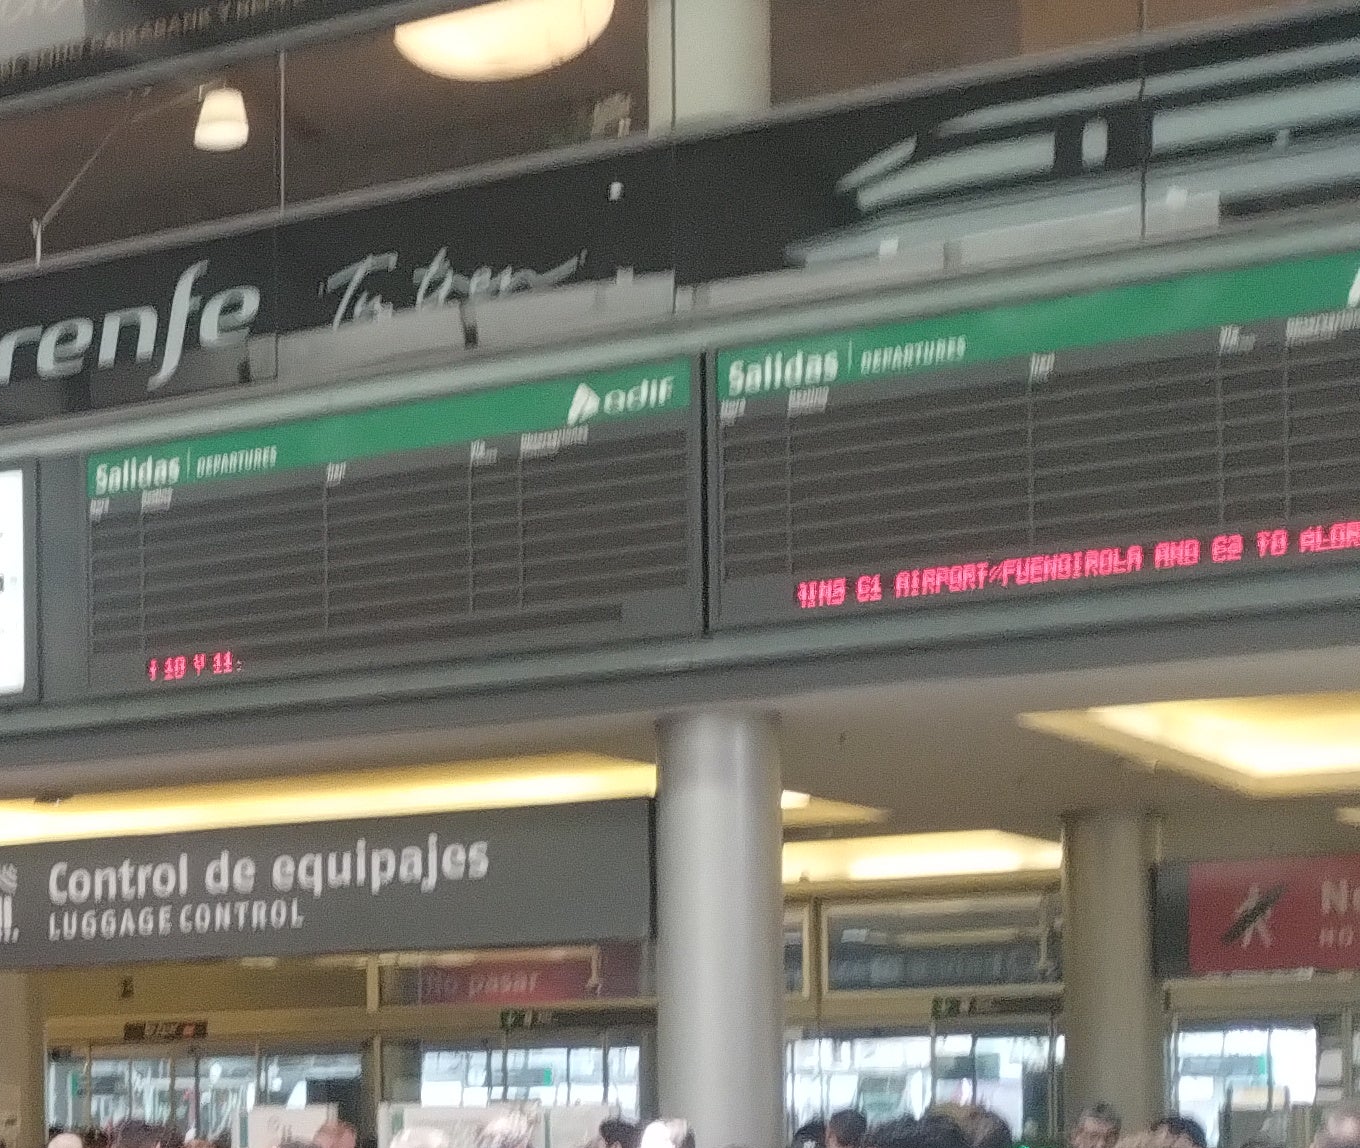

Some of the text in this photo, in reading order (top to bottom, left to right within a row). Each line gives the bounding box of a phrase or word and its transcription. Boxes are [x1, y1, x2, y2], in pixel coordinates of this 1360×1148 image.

[727, 334, 967, 397] Salidas DEPARTURES
[603, 376, 676, 415] adif
[95, 445, 278, 496] Salidas DEPARTURES
[1153, 538, 1201, 569] AND
[1256, 528, 1289, 557] TO
[48, 832, 489, 905] Control de equipajes
[48, 897, 304, 942] LUGGAGE CONTROL
